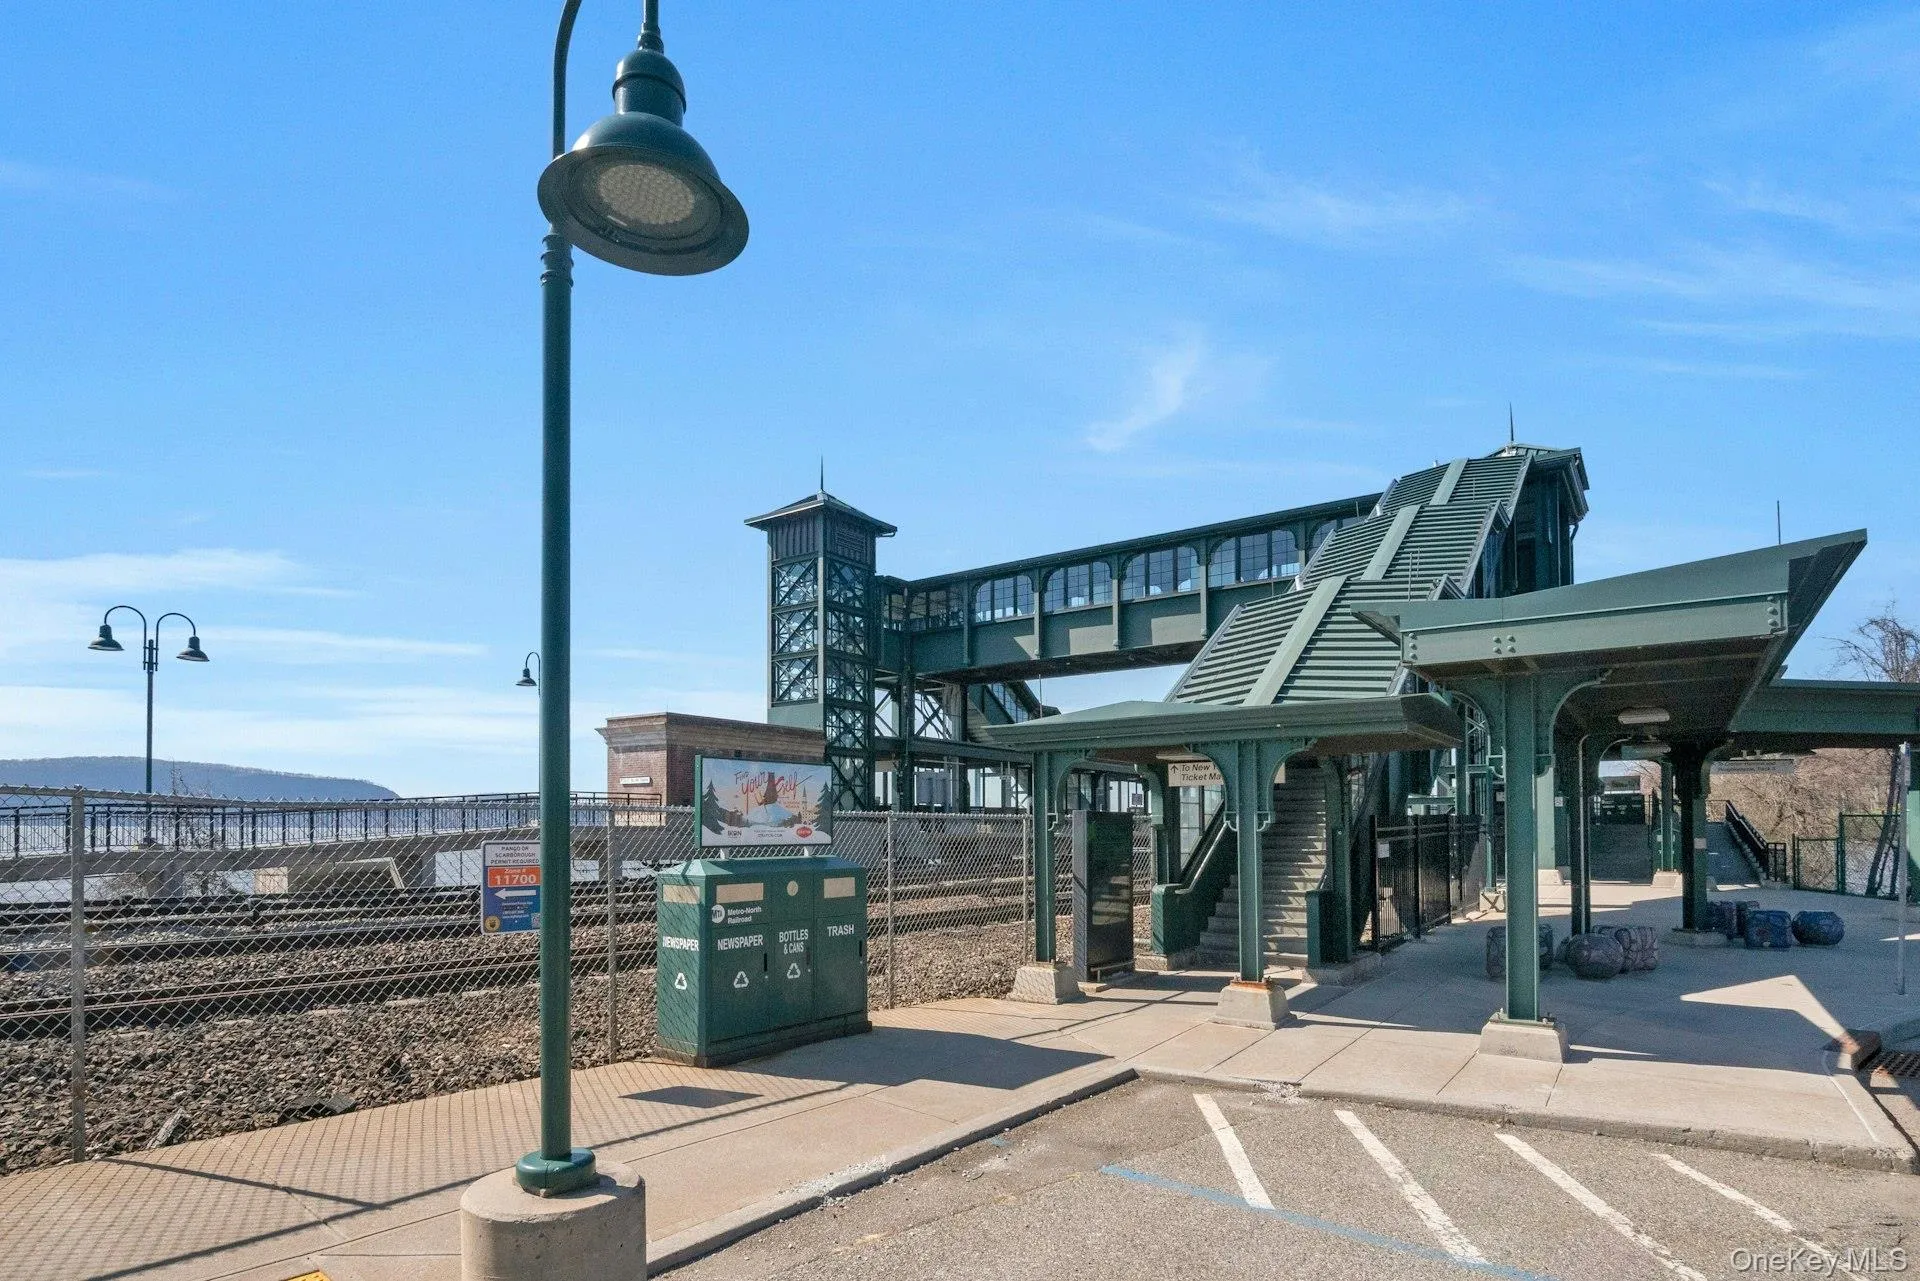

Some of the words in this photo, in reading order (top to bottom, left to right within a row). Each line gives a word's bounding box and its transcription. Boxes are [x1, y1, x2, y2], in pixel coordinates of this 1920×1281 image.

[1181, 764, 1190, 772] To
[1181, 773, 1207, 781] Ticket
[494, 874, 537, 885] 11700
[727, 906, 762, 916] Metro-North
[727, 916, 752, 924] Railroad
[778, 928, 809, 943] BOTTLES
[826, 924, 855, 937] TRASH
[662, 935, 700, 952] NEWSPAPER
[717, 934, 764, 951] NEWSPAPER
[783, 943, 788, 955] &
[788, 941, 804, 954] CANS
